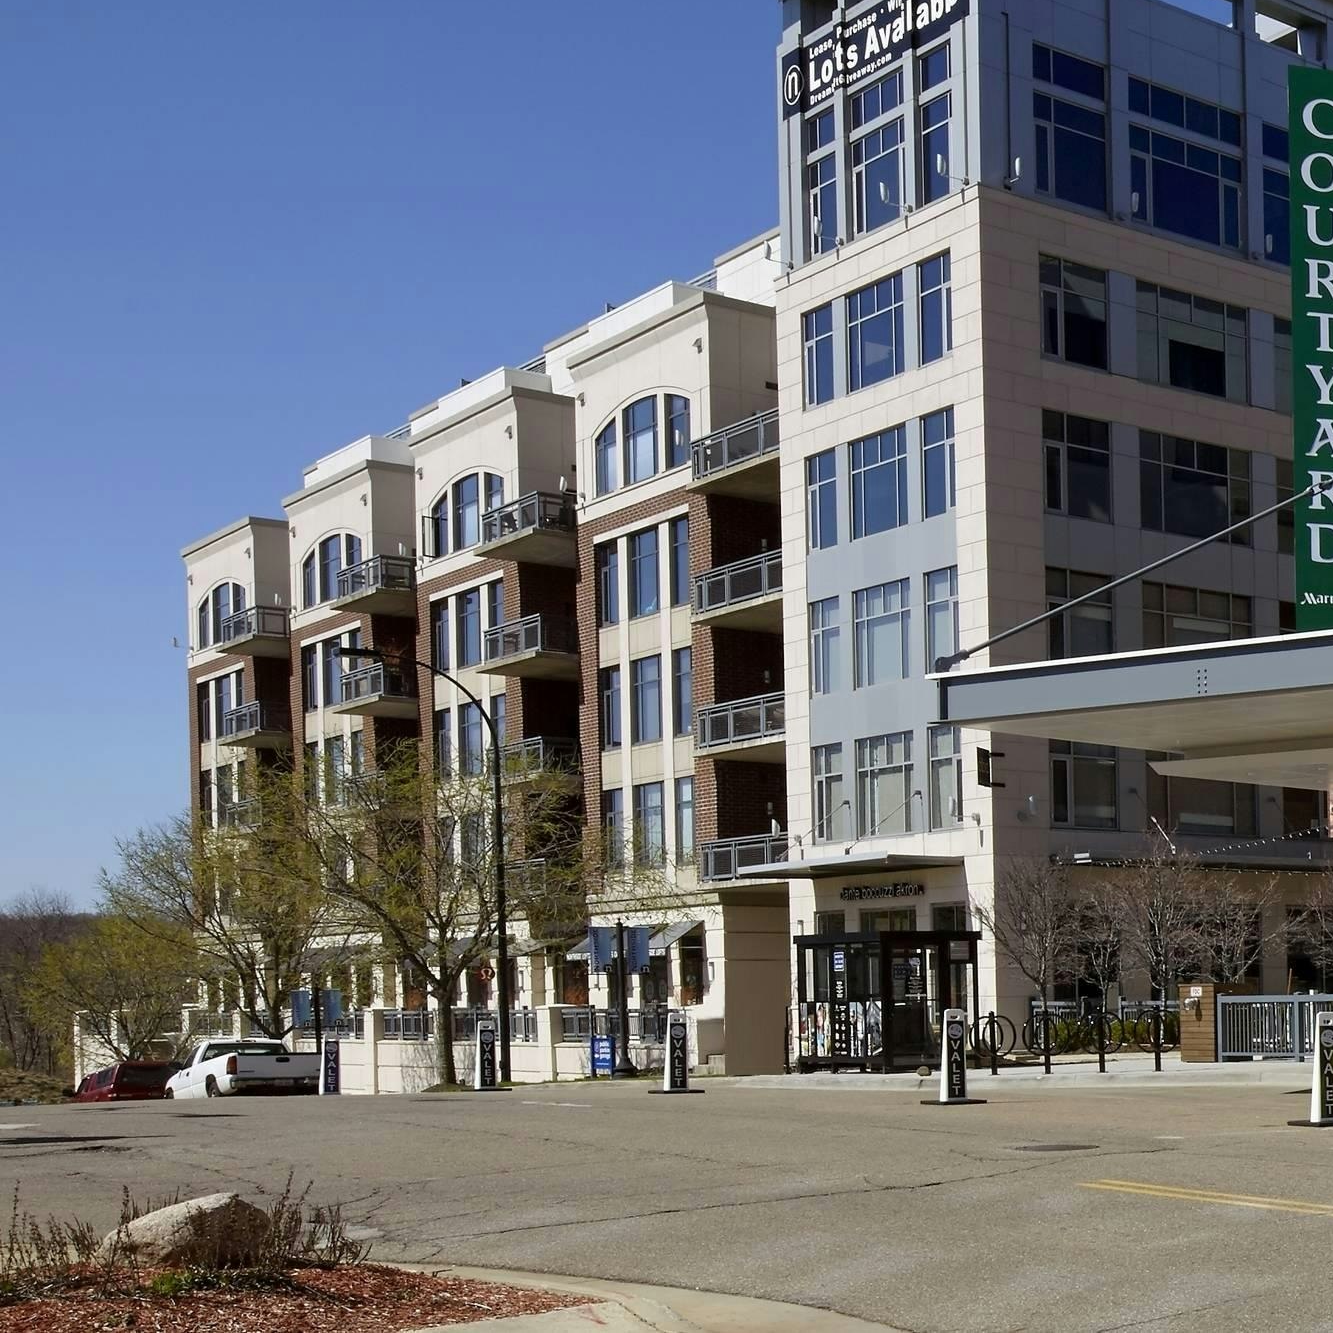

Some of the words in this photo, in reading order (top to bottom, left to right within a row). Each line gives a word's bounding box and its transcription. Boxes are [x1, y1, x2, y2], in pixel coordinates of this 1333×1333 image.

[327, 1053, 337, 1091] VALET
[483, 1044, 492, 1085] VALET
[673, 1039, 684, 1086] VALET
[951, 1040, 961, 1095] VALET
